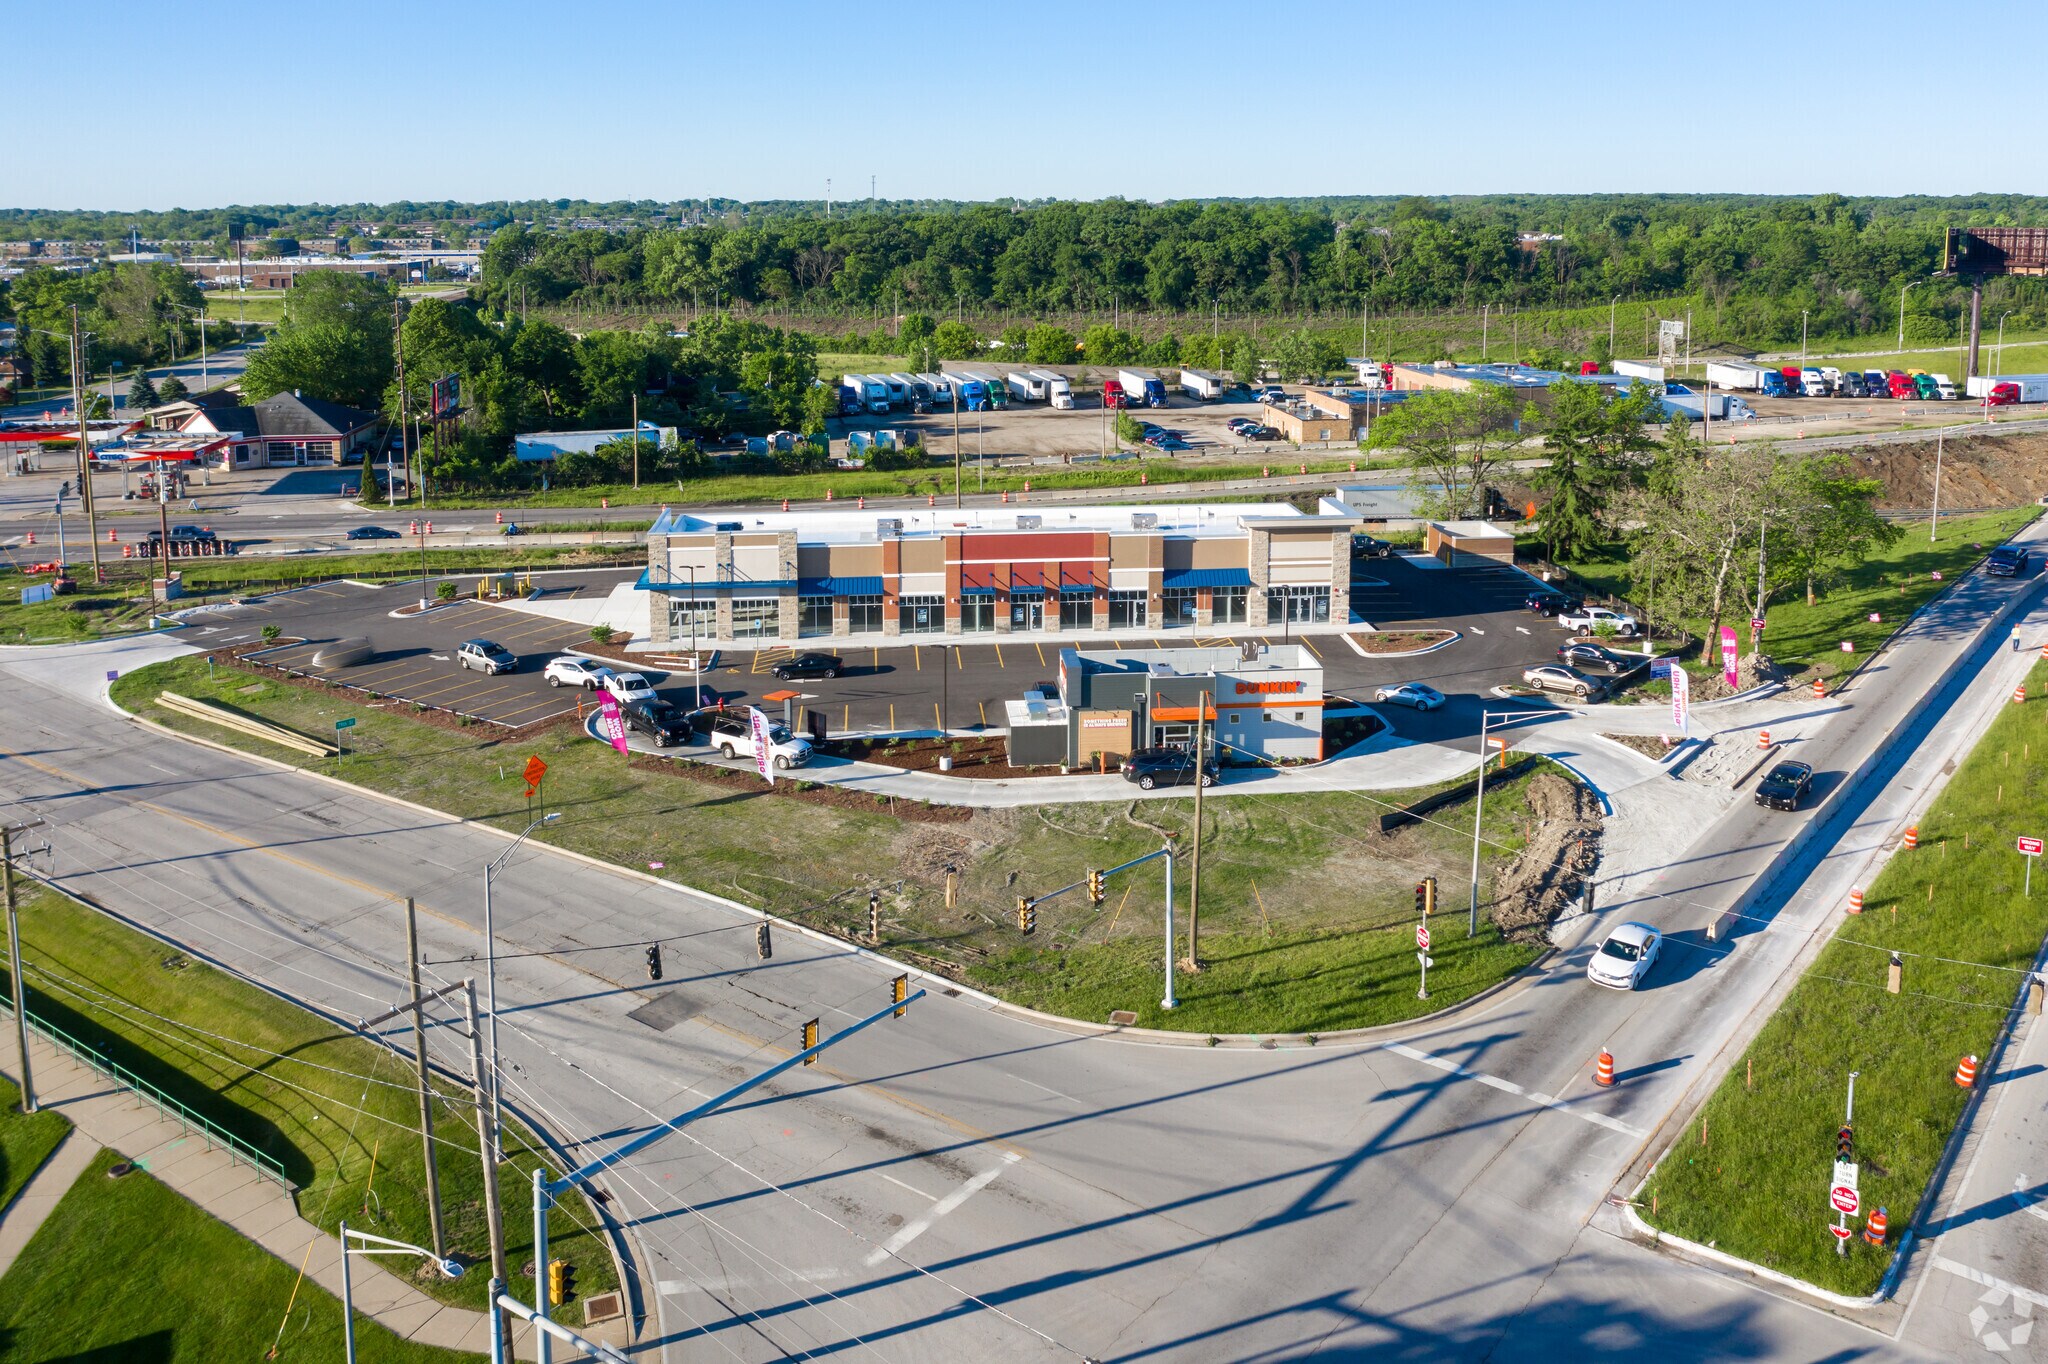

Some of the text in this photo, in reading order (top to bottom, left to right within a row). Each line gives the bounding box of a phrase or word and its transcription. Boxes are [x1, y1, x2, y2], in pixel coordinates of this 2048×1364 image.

[1236, 681, 1301, 695] DUNKIN'
[1836, 1176, 1853, 1184] SIGNAL
[1836, 1201, 1852, 1209] ENTER
